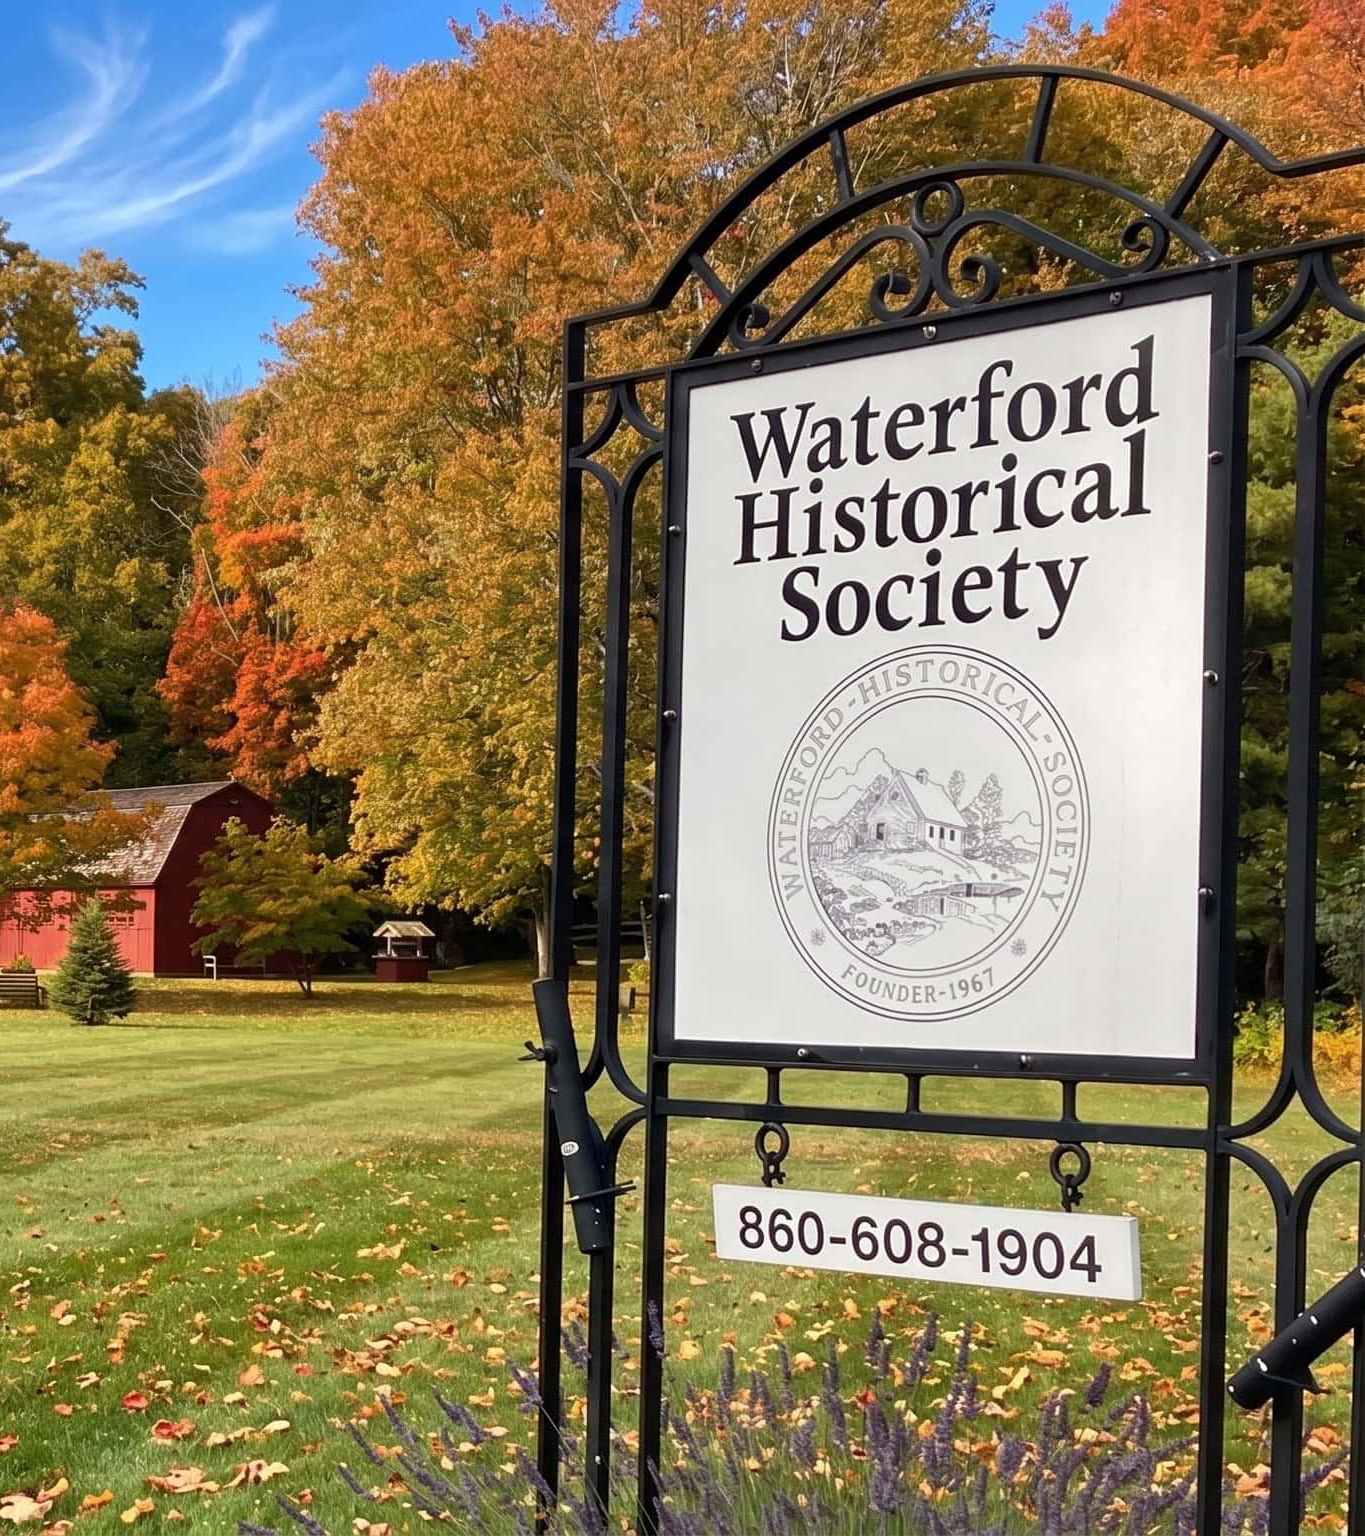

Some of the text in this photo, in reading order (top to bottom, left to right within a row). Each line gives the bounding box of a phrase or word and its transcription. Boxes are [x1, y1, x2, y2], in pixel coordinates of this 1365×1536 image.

[730, 334, 1160, 484] Waterford
[733, 429, 1151, 566] Historical
[780, 546, 1089, 641] Society
[738, 1205, 1102, 1283] 860-608-1904
